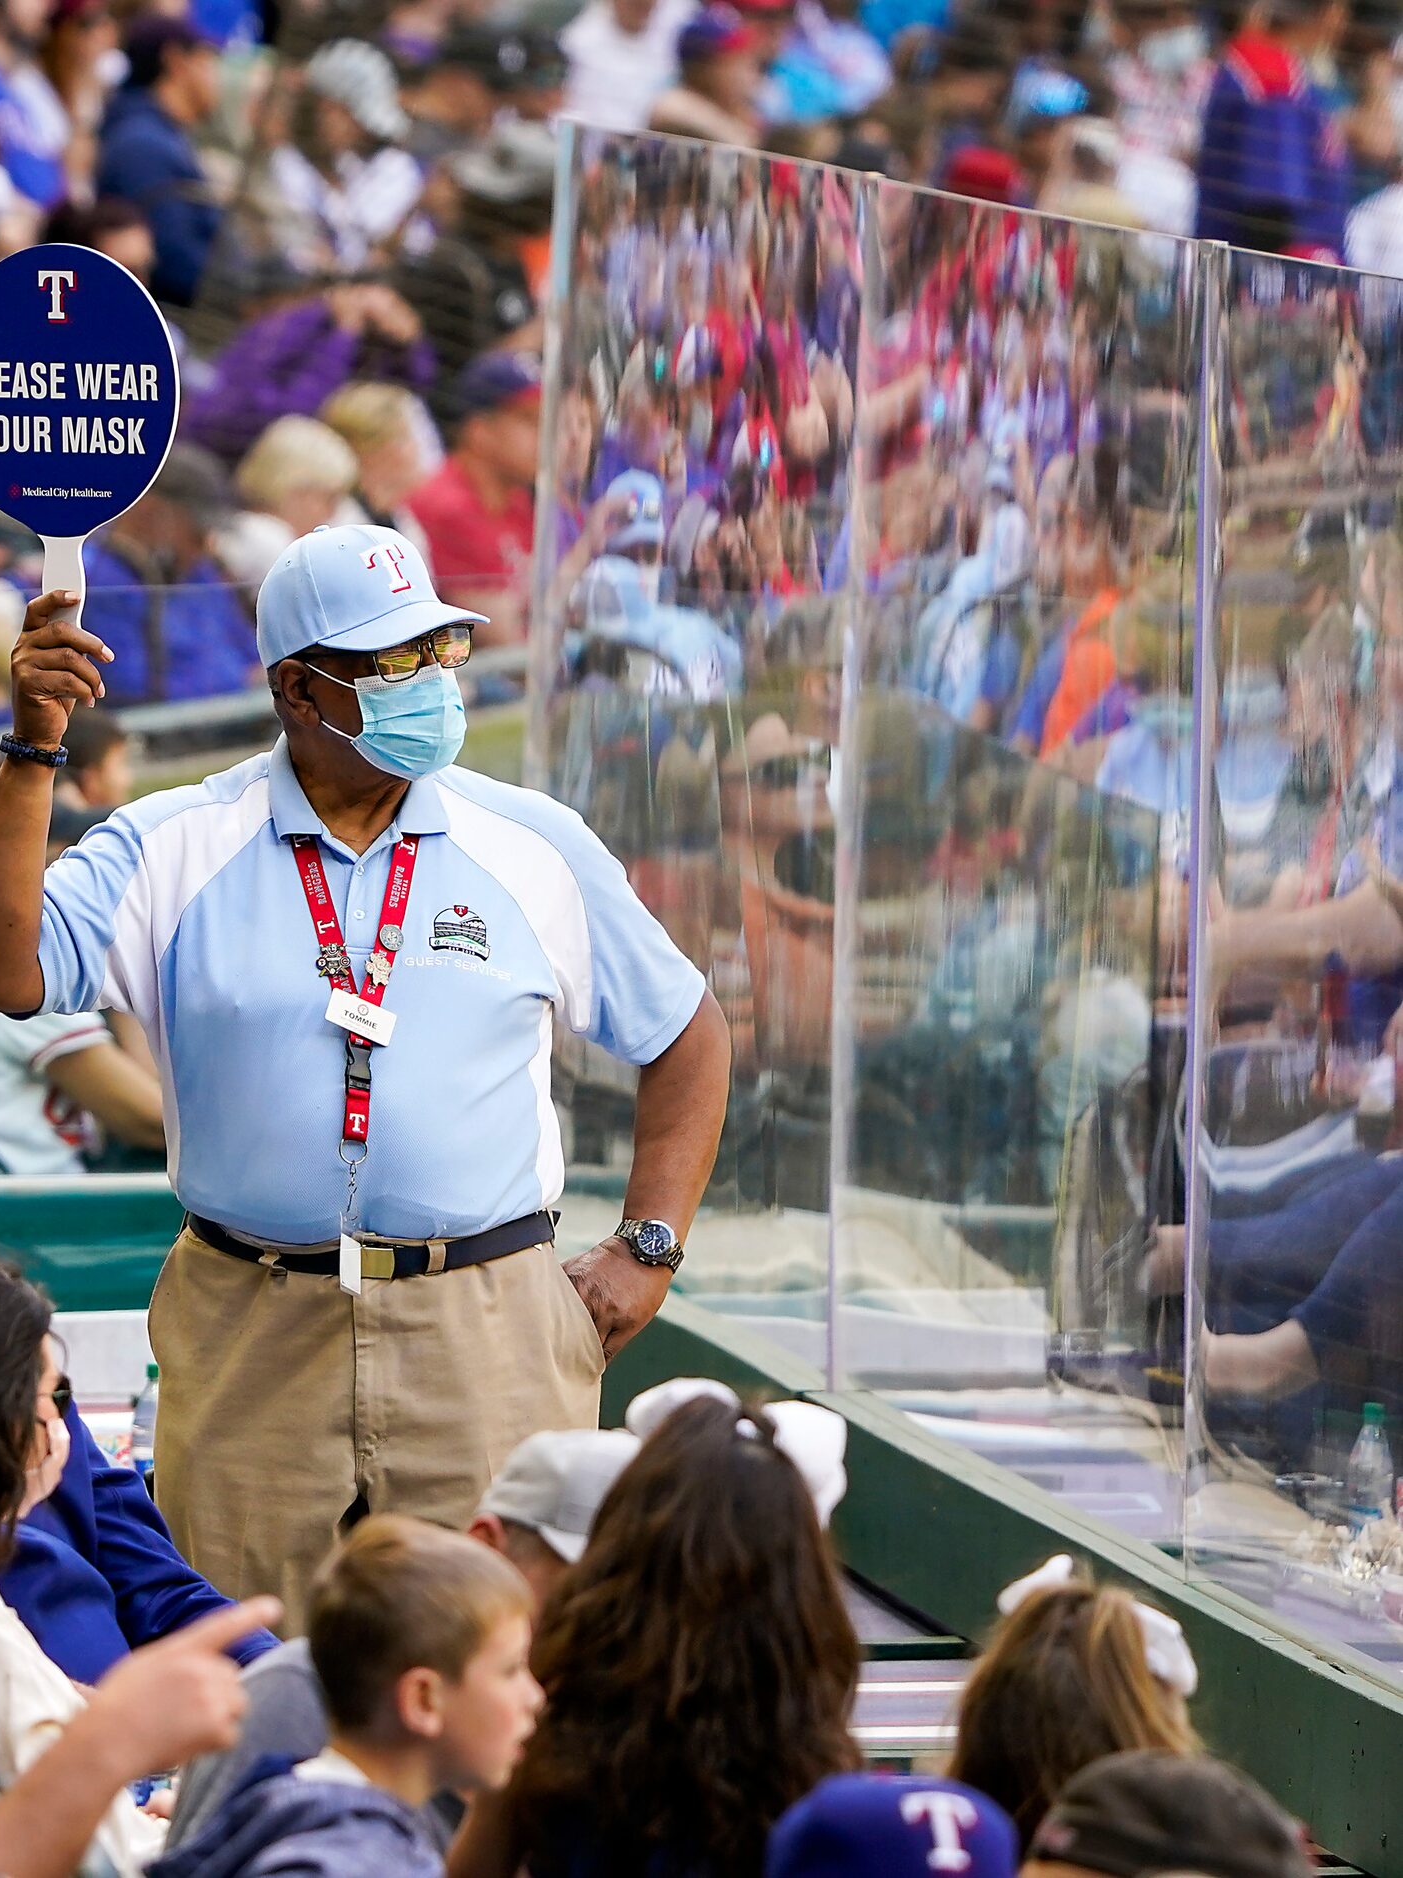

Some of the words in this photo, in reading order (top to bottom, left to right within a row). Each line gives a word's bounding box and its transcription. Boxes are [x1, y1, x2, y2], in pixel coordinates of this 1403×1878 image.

[37, 269, 77, 323] T
[75, 363, 159, 401] WEAR
[61, 416, 146, 455] MASK
[22, 487, 53, 497] Medical
[53, 487, 69, 499] City
[70, 488, 112, 498] Healthcare
[359, 542, 412, 594] T
[398, 841, 416, 856] T
[304, 875, 315, 896] TEXAS
[307, 861, 328, 905] RANGERS
[388, 865, 406, 908] RANGERS
[400, 879, 409, 899] TEXAS
[316, 919, 336, 934] T
[404, 956, 451, 967] GUEST
[454, 960, 512, 982] SERVICES
[344, 1010, 378, 1030] TOMMIE
[349, 1113, 366, 1134] T
[899, 1790, 978, 1872] T
